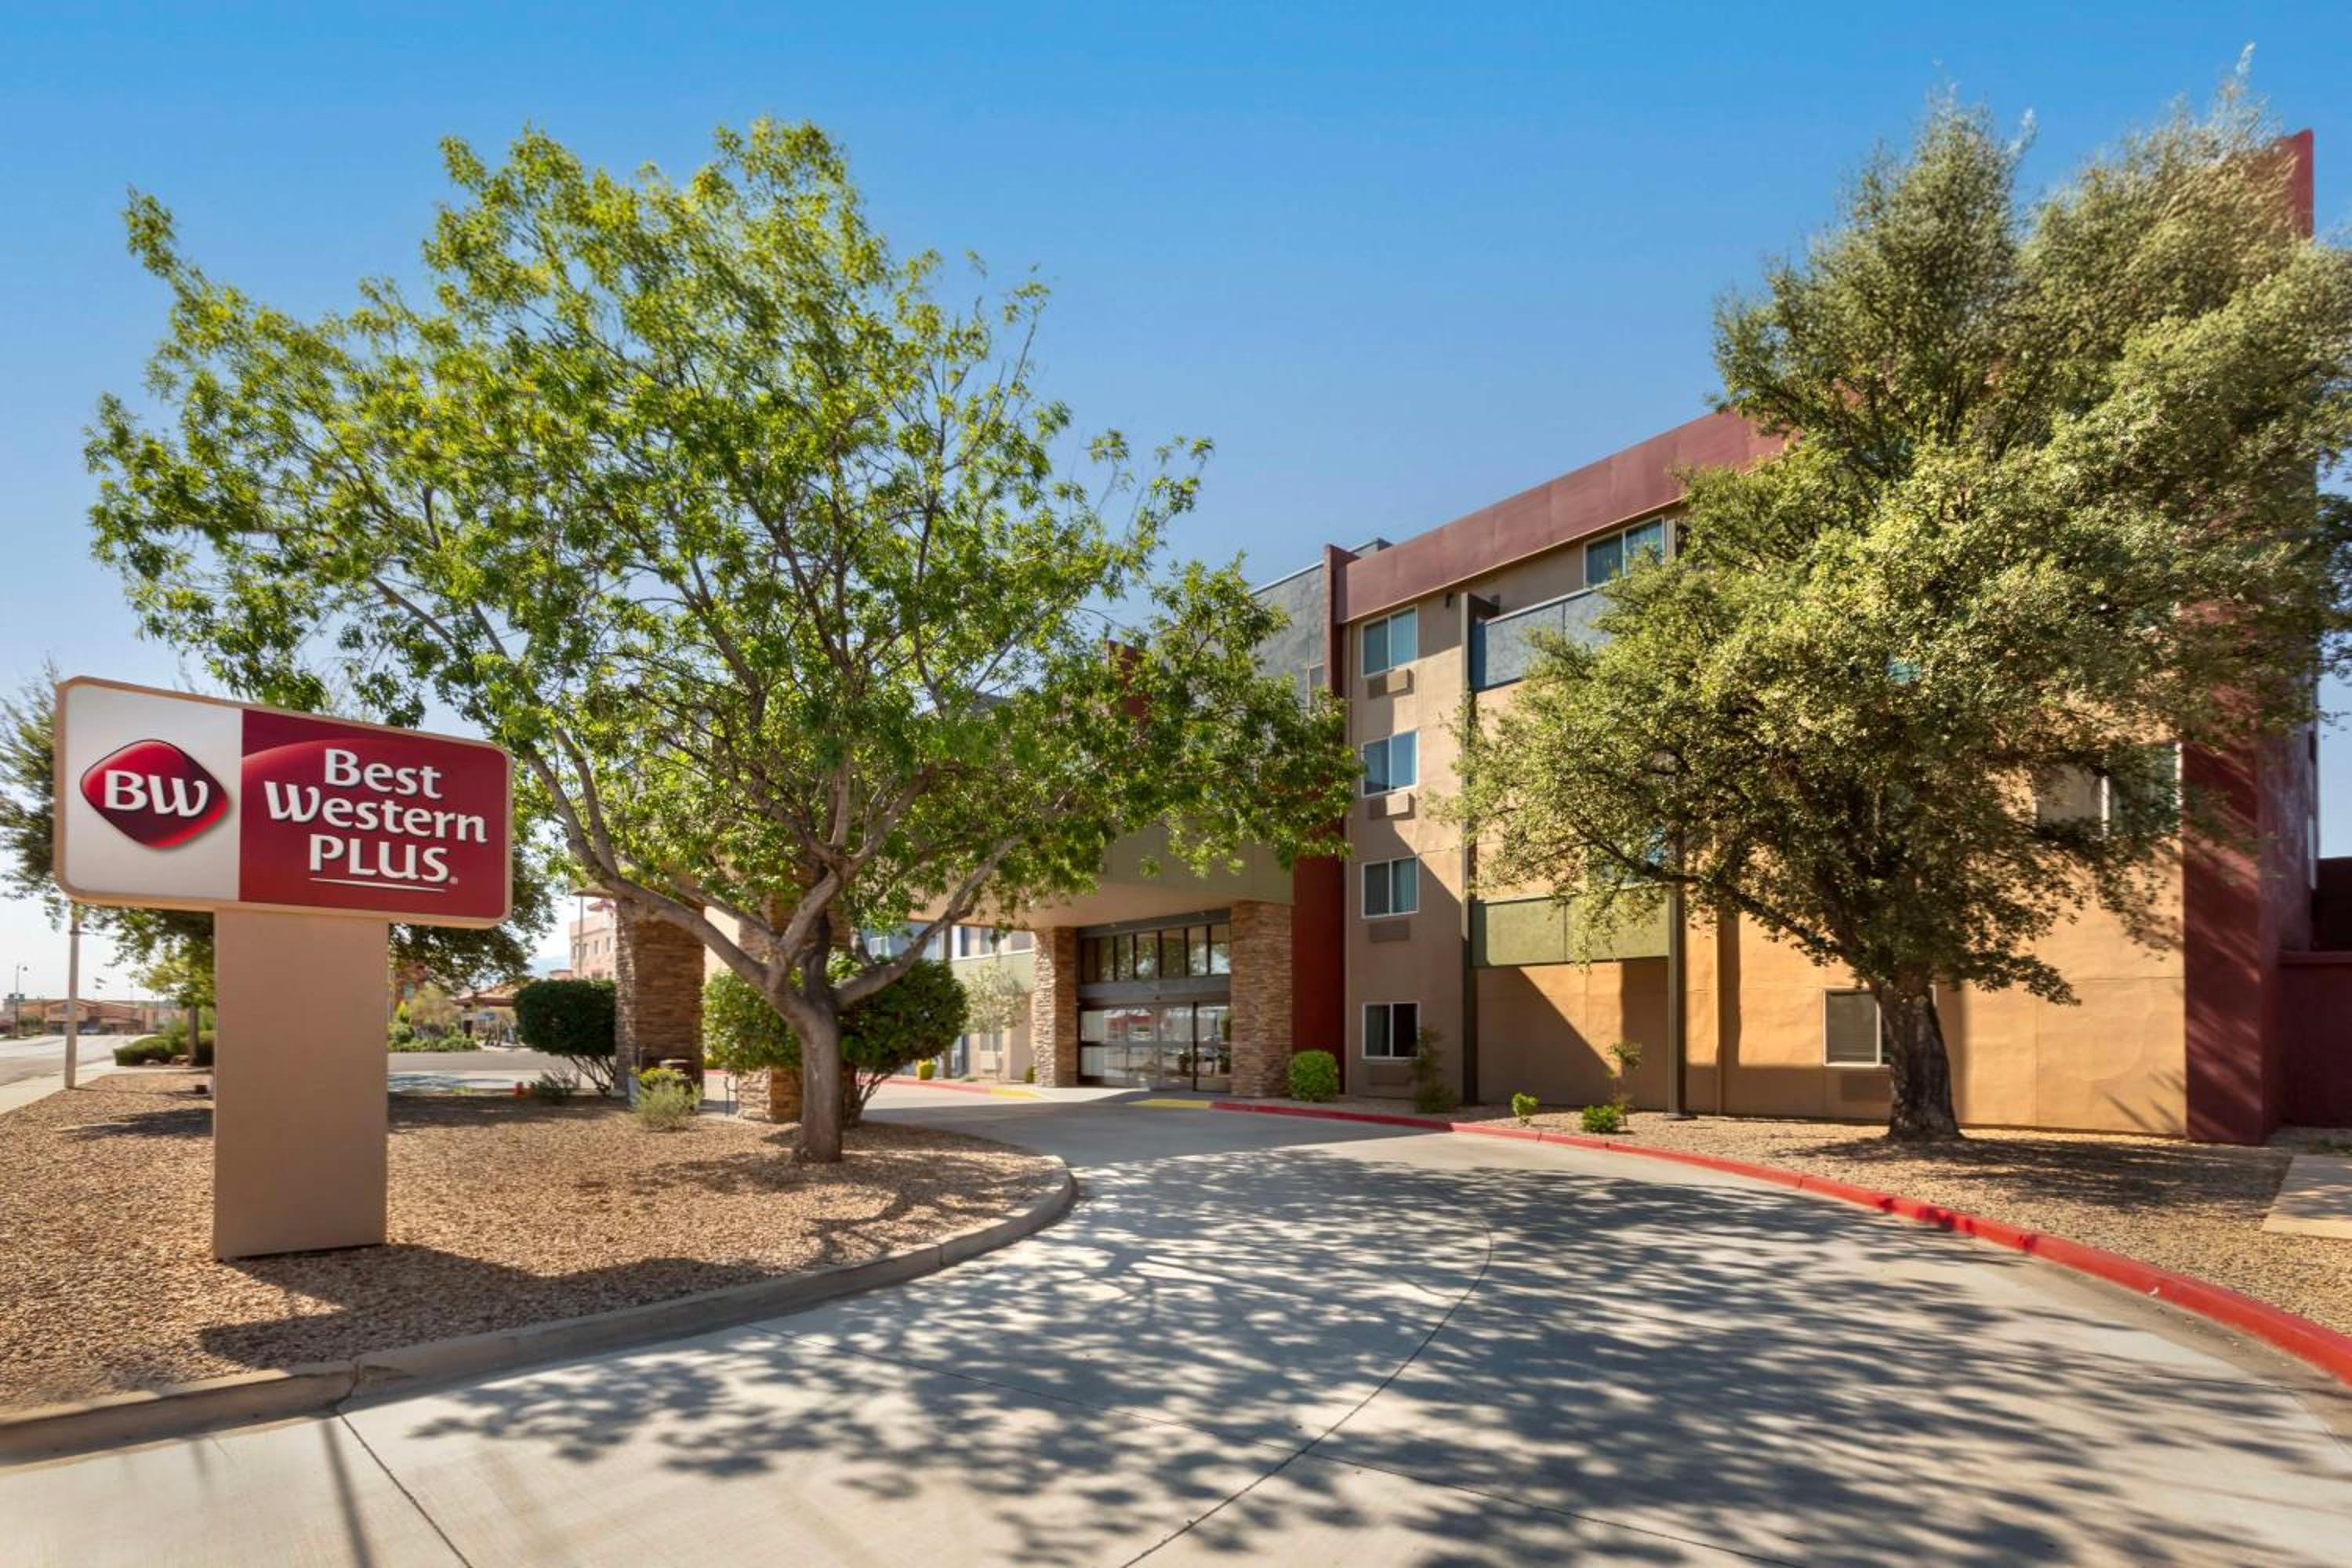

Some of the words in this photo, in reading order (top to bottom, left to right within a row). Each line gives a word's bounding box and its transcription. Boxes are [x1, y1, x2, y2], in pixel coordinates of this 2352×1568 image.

[104, 769, 209, 818] BW
[325, 748, 442, 799] Best
[264, 781, 488, 844] Western
[310, 833, 449, 882] PLUS
